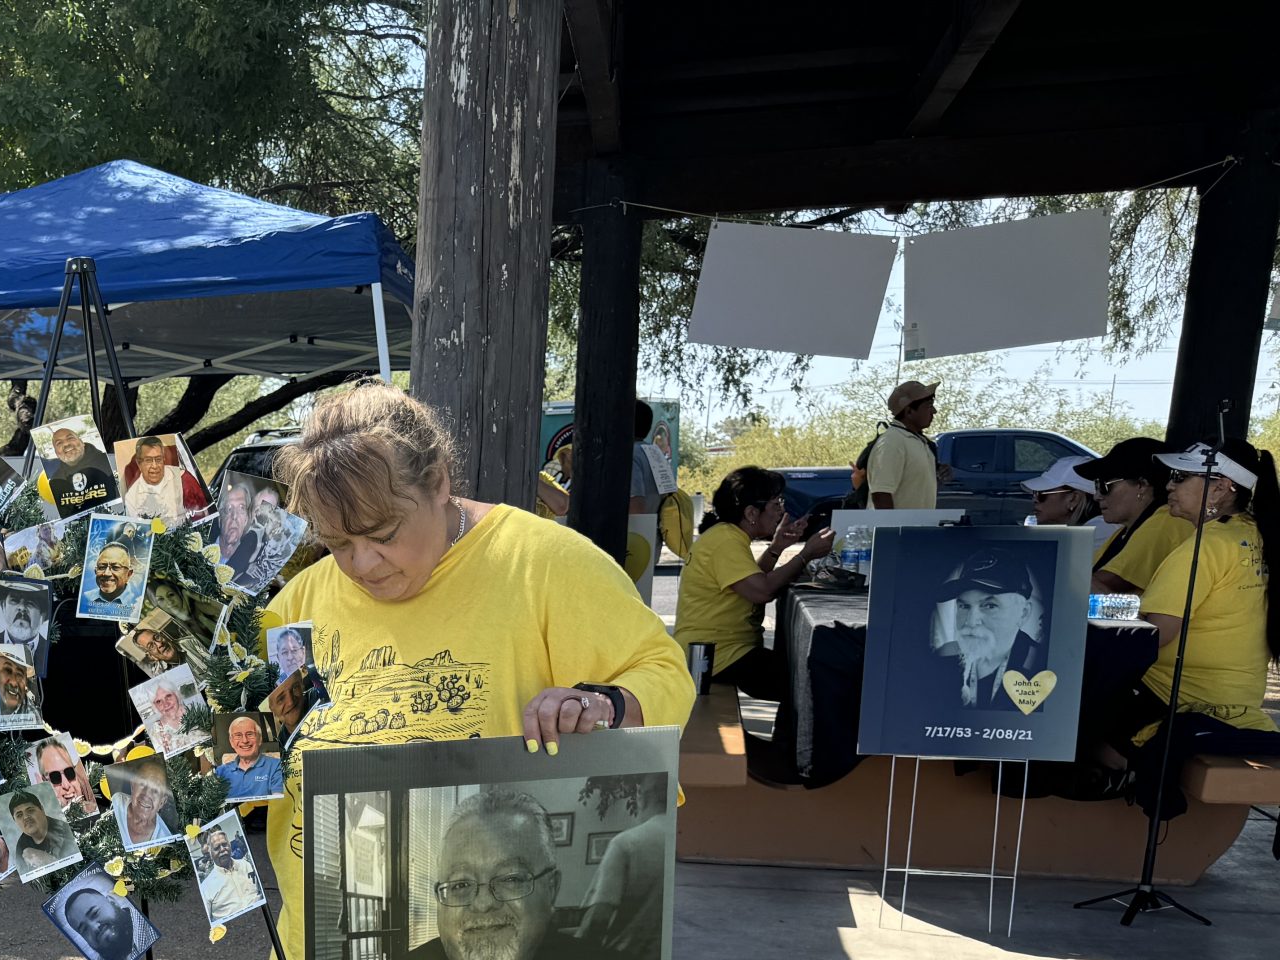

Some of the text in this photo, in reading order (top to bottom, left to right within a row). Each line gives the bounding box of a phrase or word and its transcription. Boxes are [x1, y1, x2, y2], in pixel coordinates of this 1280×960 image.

[1018, 698, 1036, 706] Maly
[925, 727, 972, 738] 7/17/53
[983, 728, 1033, 741] 2/08/21
